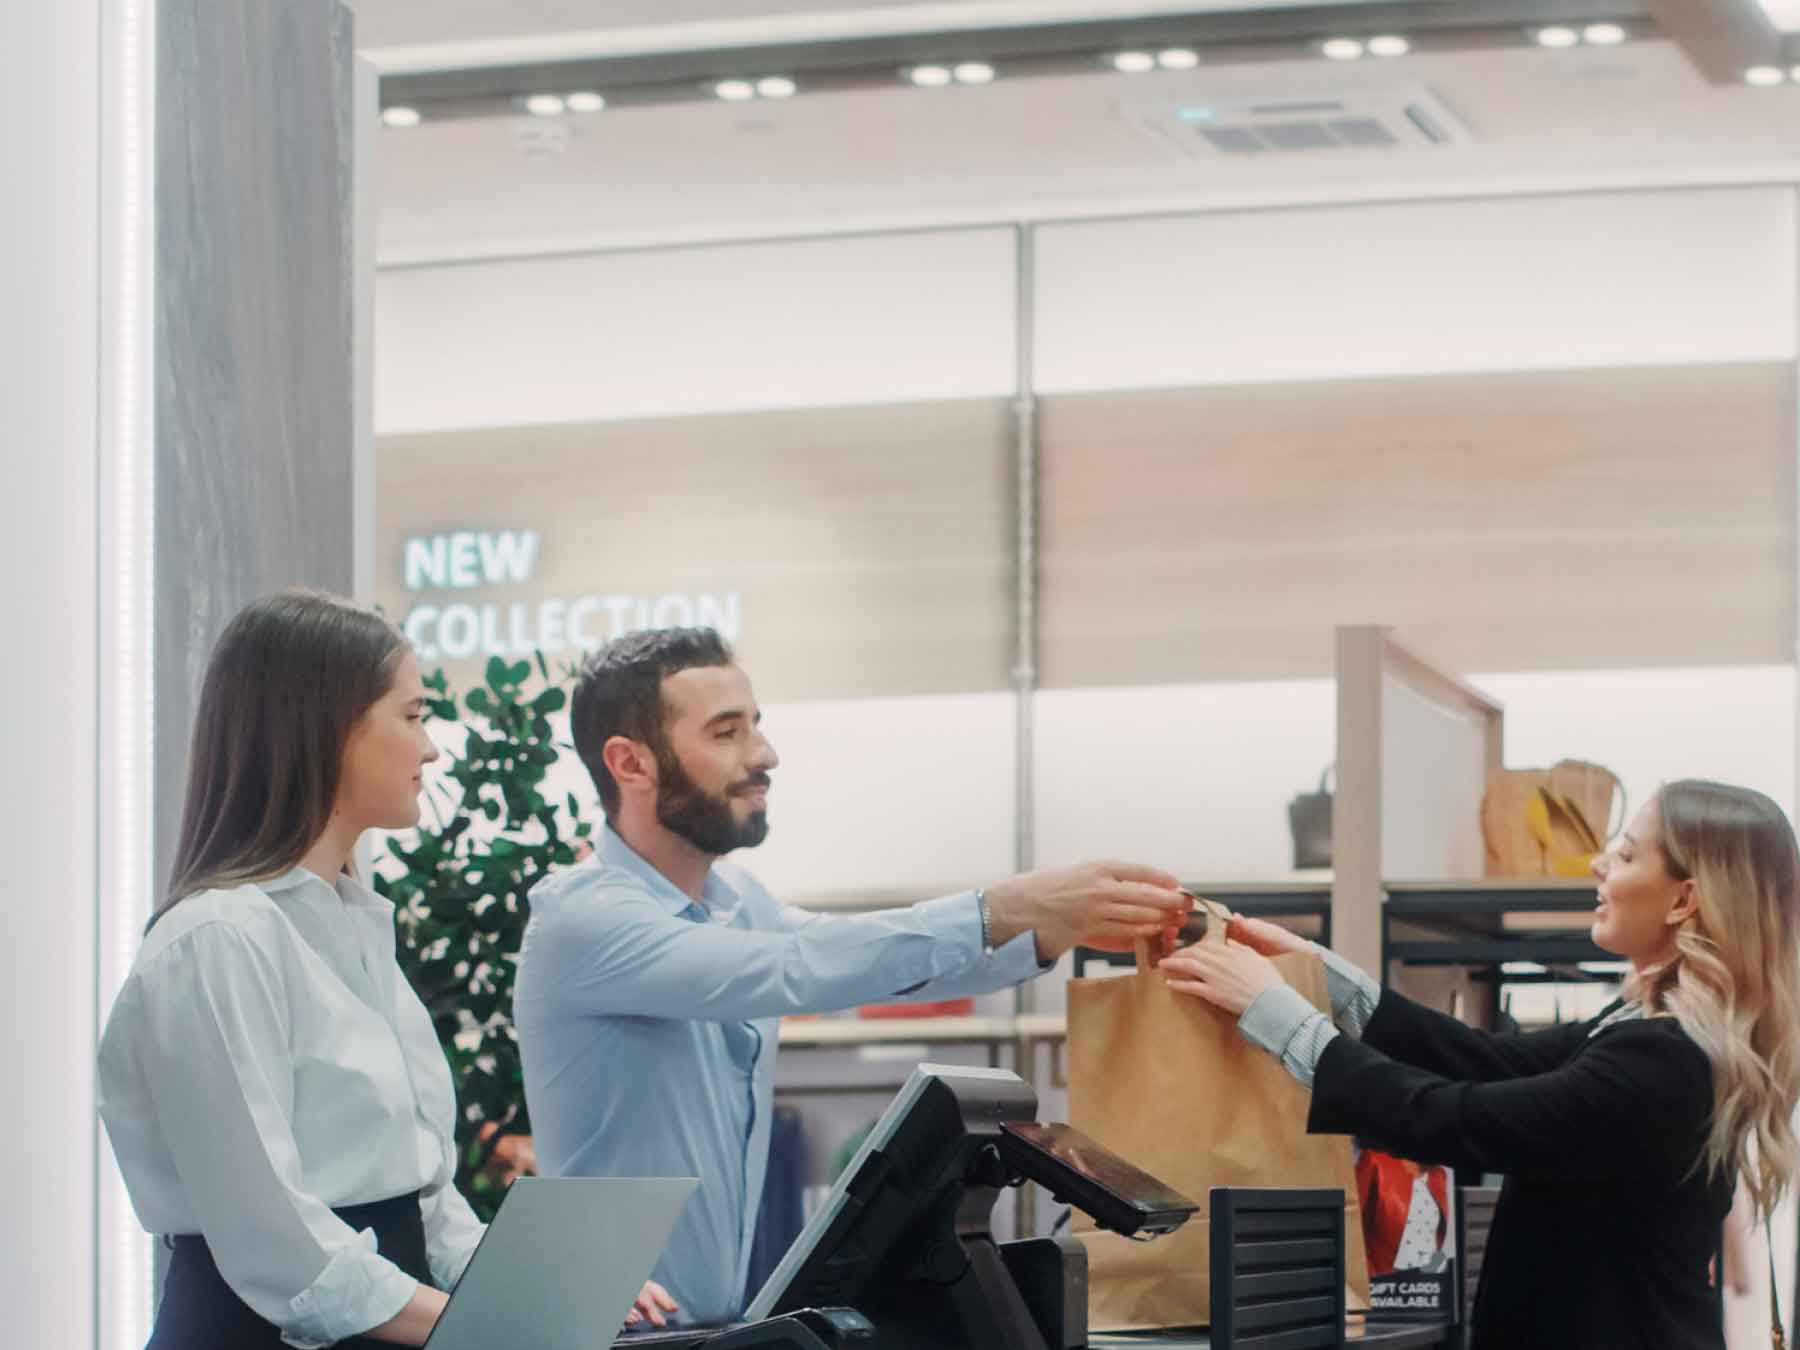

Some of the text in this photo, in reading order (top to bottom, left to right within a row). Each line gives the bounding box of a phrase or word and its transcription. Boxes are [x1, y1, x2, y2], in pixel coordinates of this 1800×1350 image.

[405, 531, 537, 588] NEW
[404, 593, 740, 658] COLLECTION
[1398, 1281, 1441, 1294] CARDS
